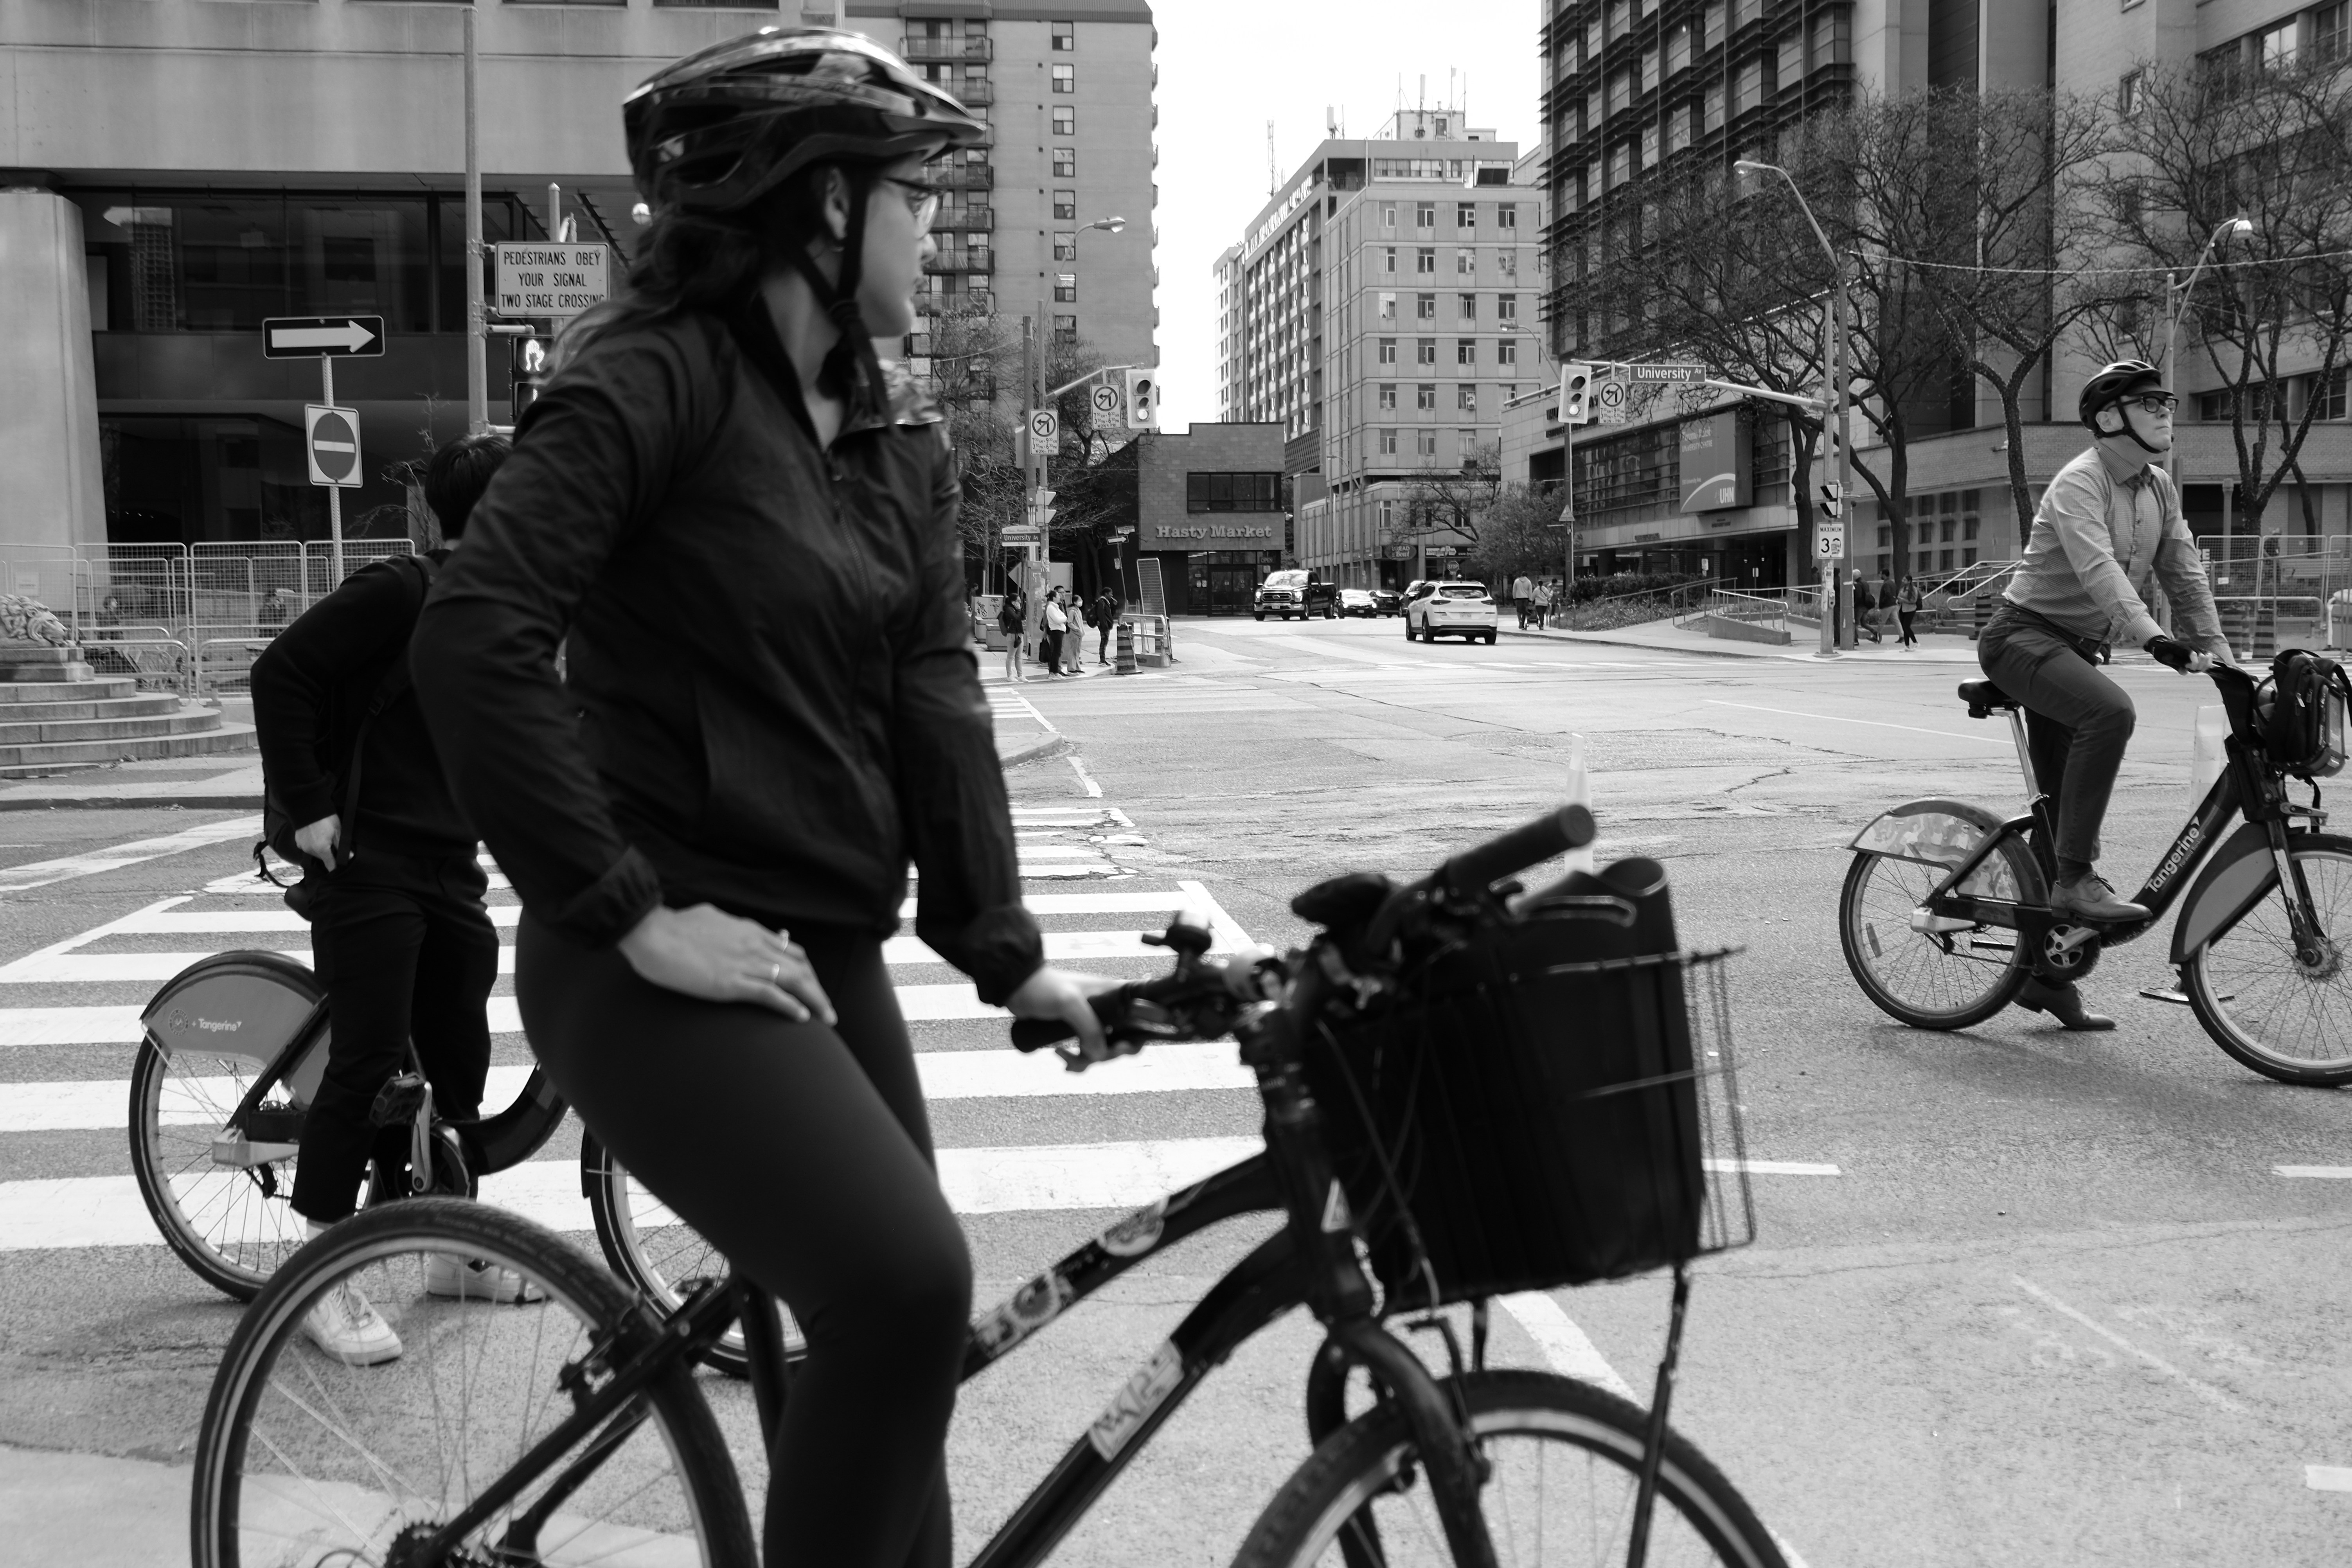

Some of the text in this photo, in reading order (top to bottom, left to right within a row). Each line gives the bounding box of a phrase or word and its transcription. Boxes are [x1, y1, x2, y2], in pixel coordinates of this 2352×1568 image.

[504, 252, 601, 266] PEDESTRIANS OBEY
[518, 273, 588, 287] YOUR SIGNAL
[501, 294, 521, 307] TWO
[525, 294, 554, 308] STAGE
[1637, 367, 1691, 382] University
[1719, 487, 1734, 503] UHN
[1156, 525, 1271, 539] Hasty Market
[2144, 827, 2200, 893] Tangerine
[198, 1018, 237, 1032] Tangerine
